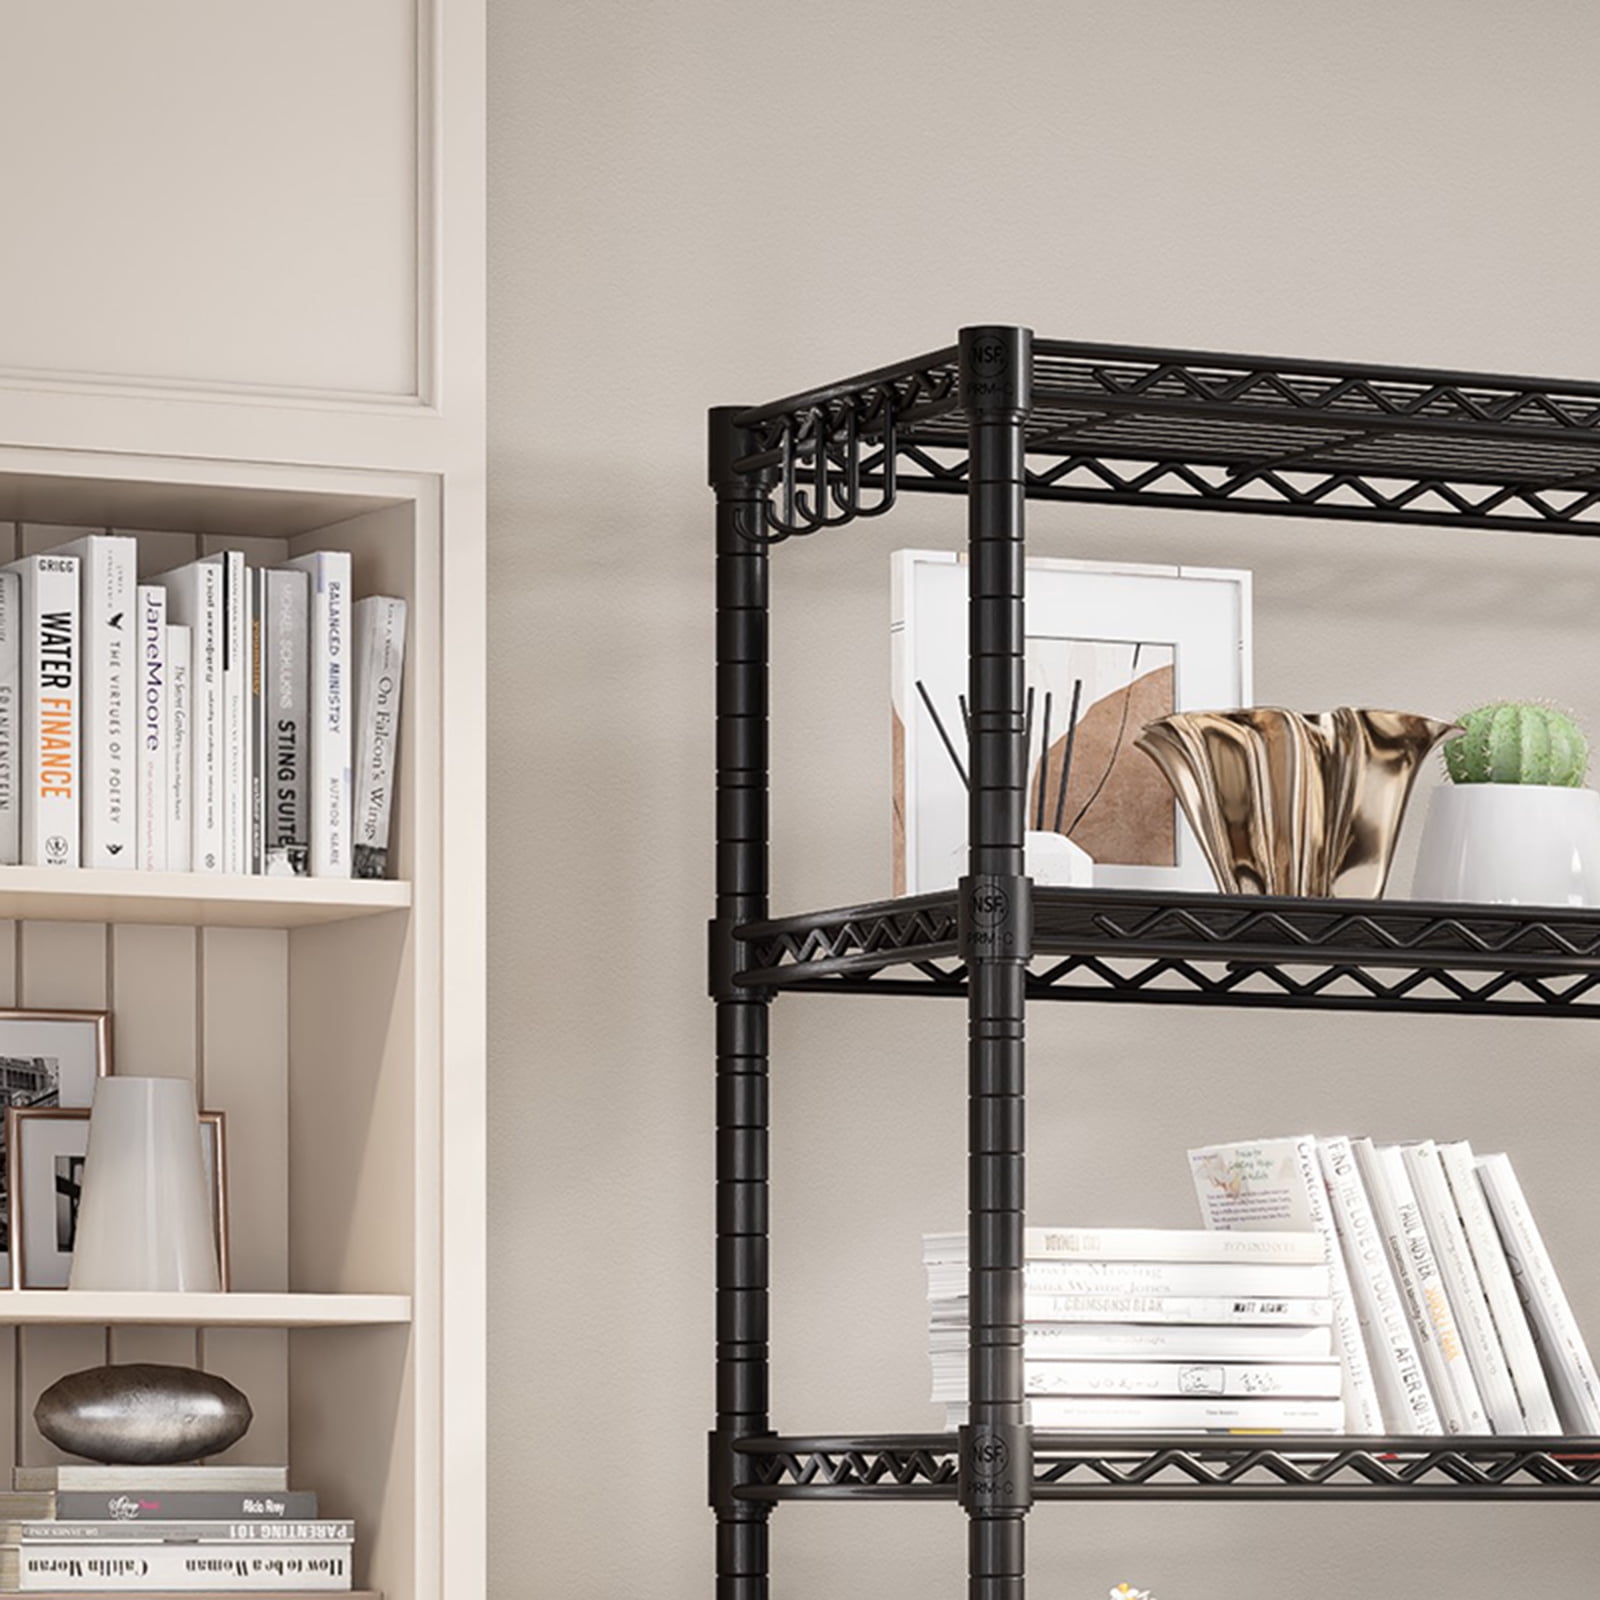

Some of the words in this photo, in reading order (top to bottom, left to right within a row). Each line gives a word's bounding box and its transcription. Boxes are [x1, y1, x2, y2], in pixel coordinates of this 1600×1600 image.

[39, 560, 74, 573] GRIGG
[329, 581, 340, 656] BALANCED
[41, 612, 72, 688] WATER
[109, 641, 121, 667] THE
[109, 675, 121, 735] VIRTUES
[329, 662, 340, 734] MINISTRY
[378, 677, 393, 706] On
[41, 697, 72, 798] FINANCE
[109, 742, 121, 760] OF
[278, 720, 296, 781] STING
[372, 710, 391, 781] Falcon's
[109, 768, 121, 824] POETRY
[365, 787, 384, 842] Wings
[1398, 1202, 1417, 1235] PAUL
[1396, 1346, 1421, 1394] AFTER
[229, 1524, 256, 1539] 101
[259, 1524, 348, 1539] PARENTING
[27, 1559, 85, 1577] Moran
[87, 1559, 149, 1577] Caitlin
[185, 1559, 249, 1577] Woman
[252, 1559, 263, 1571] a
[264, 1559, 284, 1576] be
[287, 1559, 303, 1575] to
[305, 1559, 343, 1576] How
